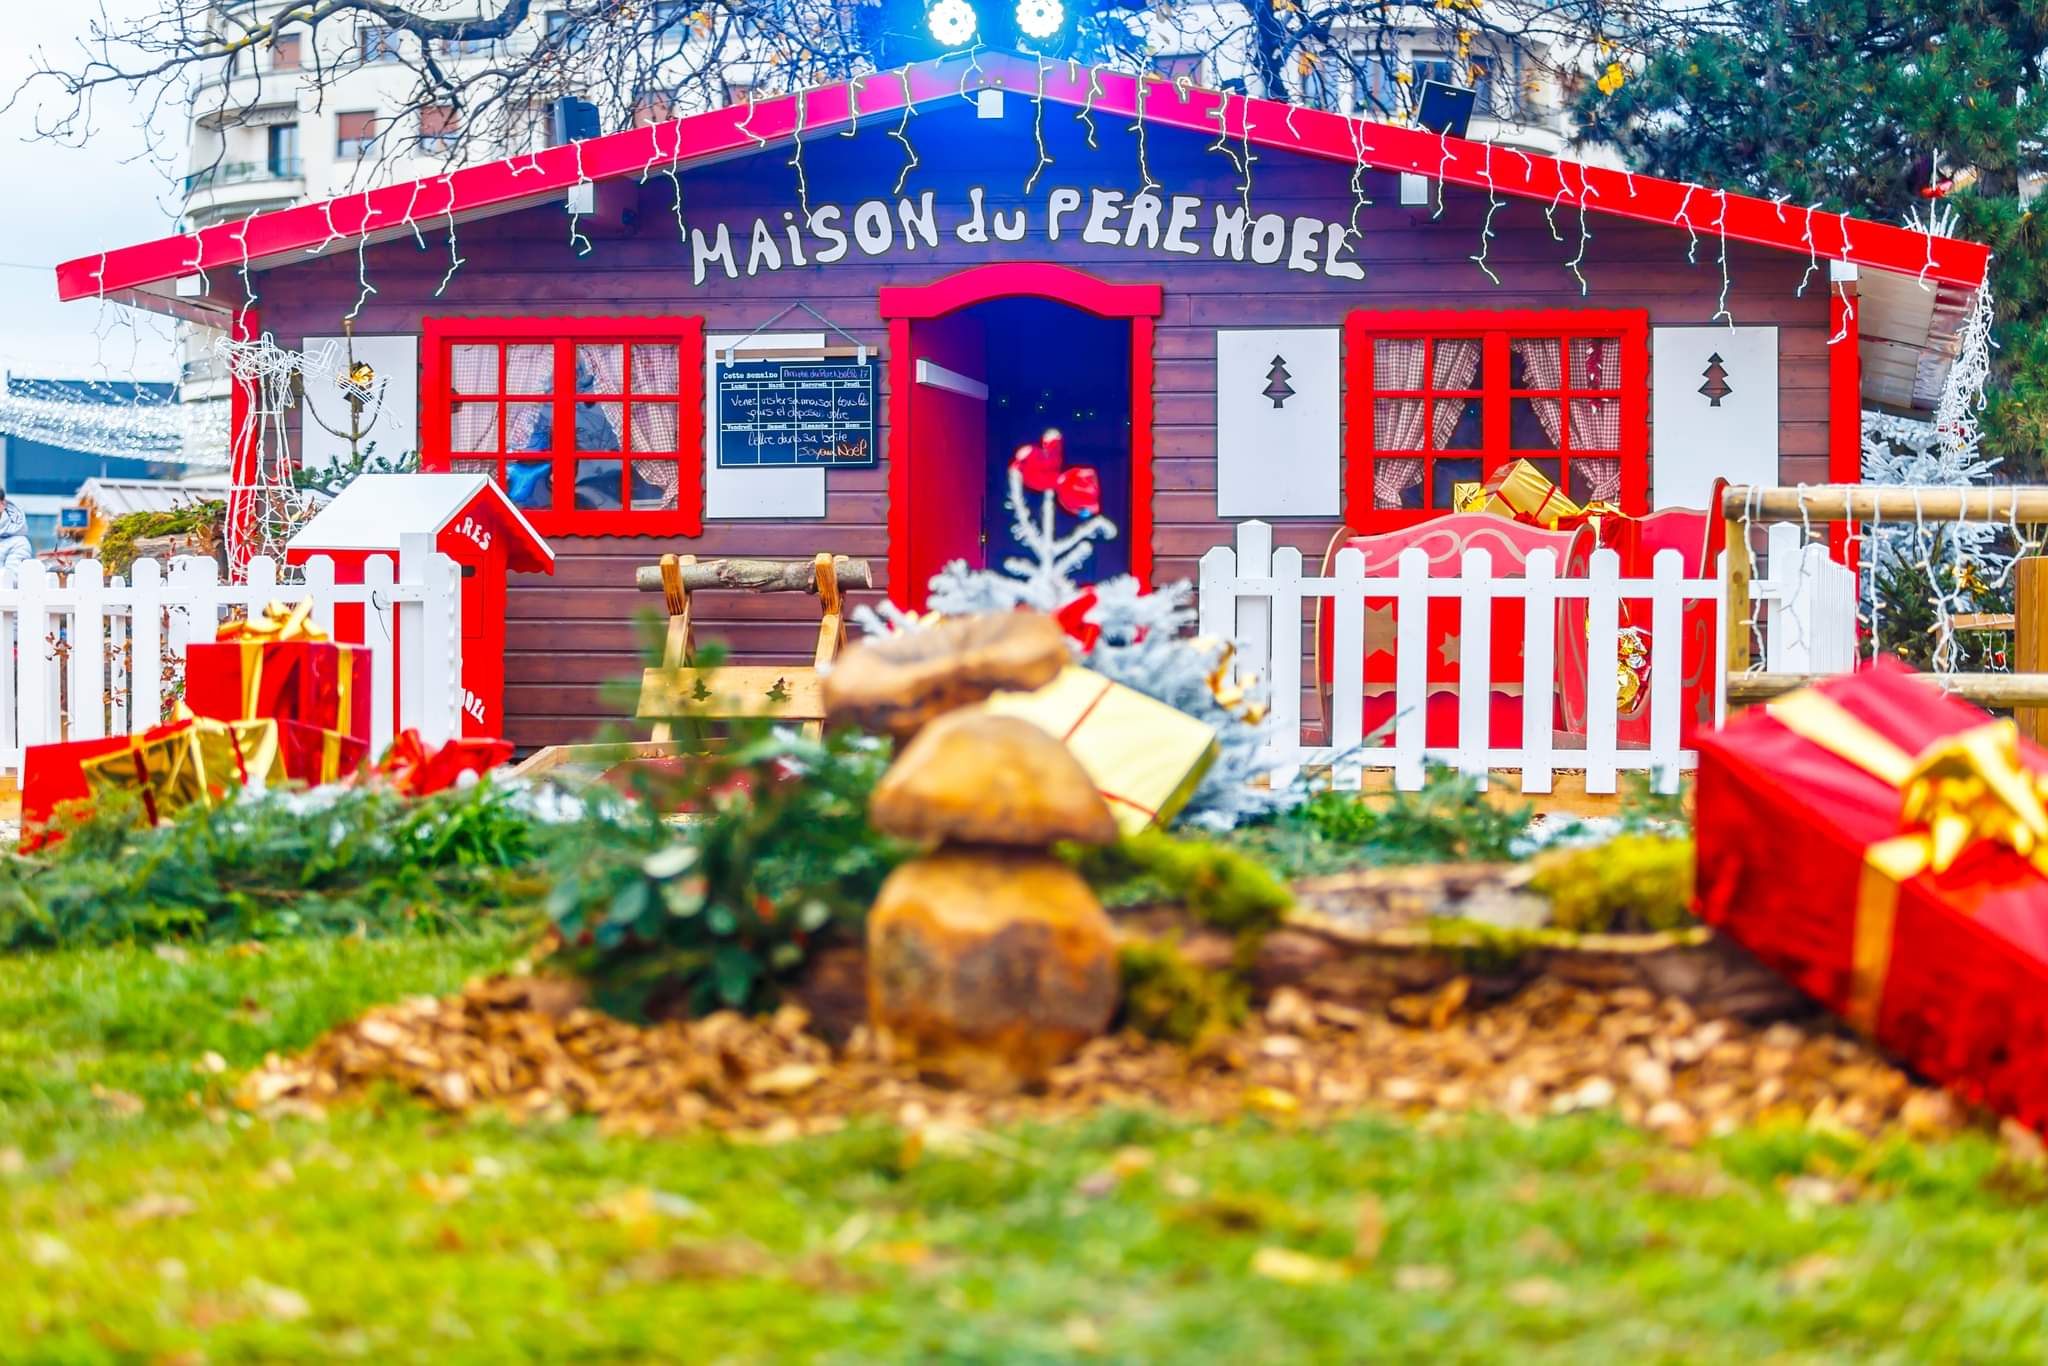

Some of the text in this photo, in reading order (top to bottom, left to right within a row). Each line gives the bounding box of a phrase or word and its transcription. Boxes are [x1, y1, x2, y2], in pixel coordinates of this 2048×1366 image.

[956, 187, 1026, 242] du
[1048, 188, 1201, 255] PERE
[1213, 204, 1366, 281] NOEL
